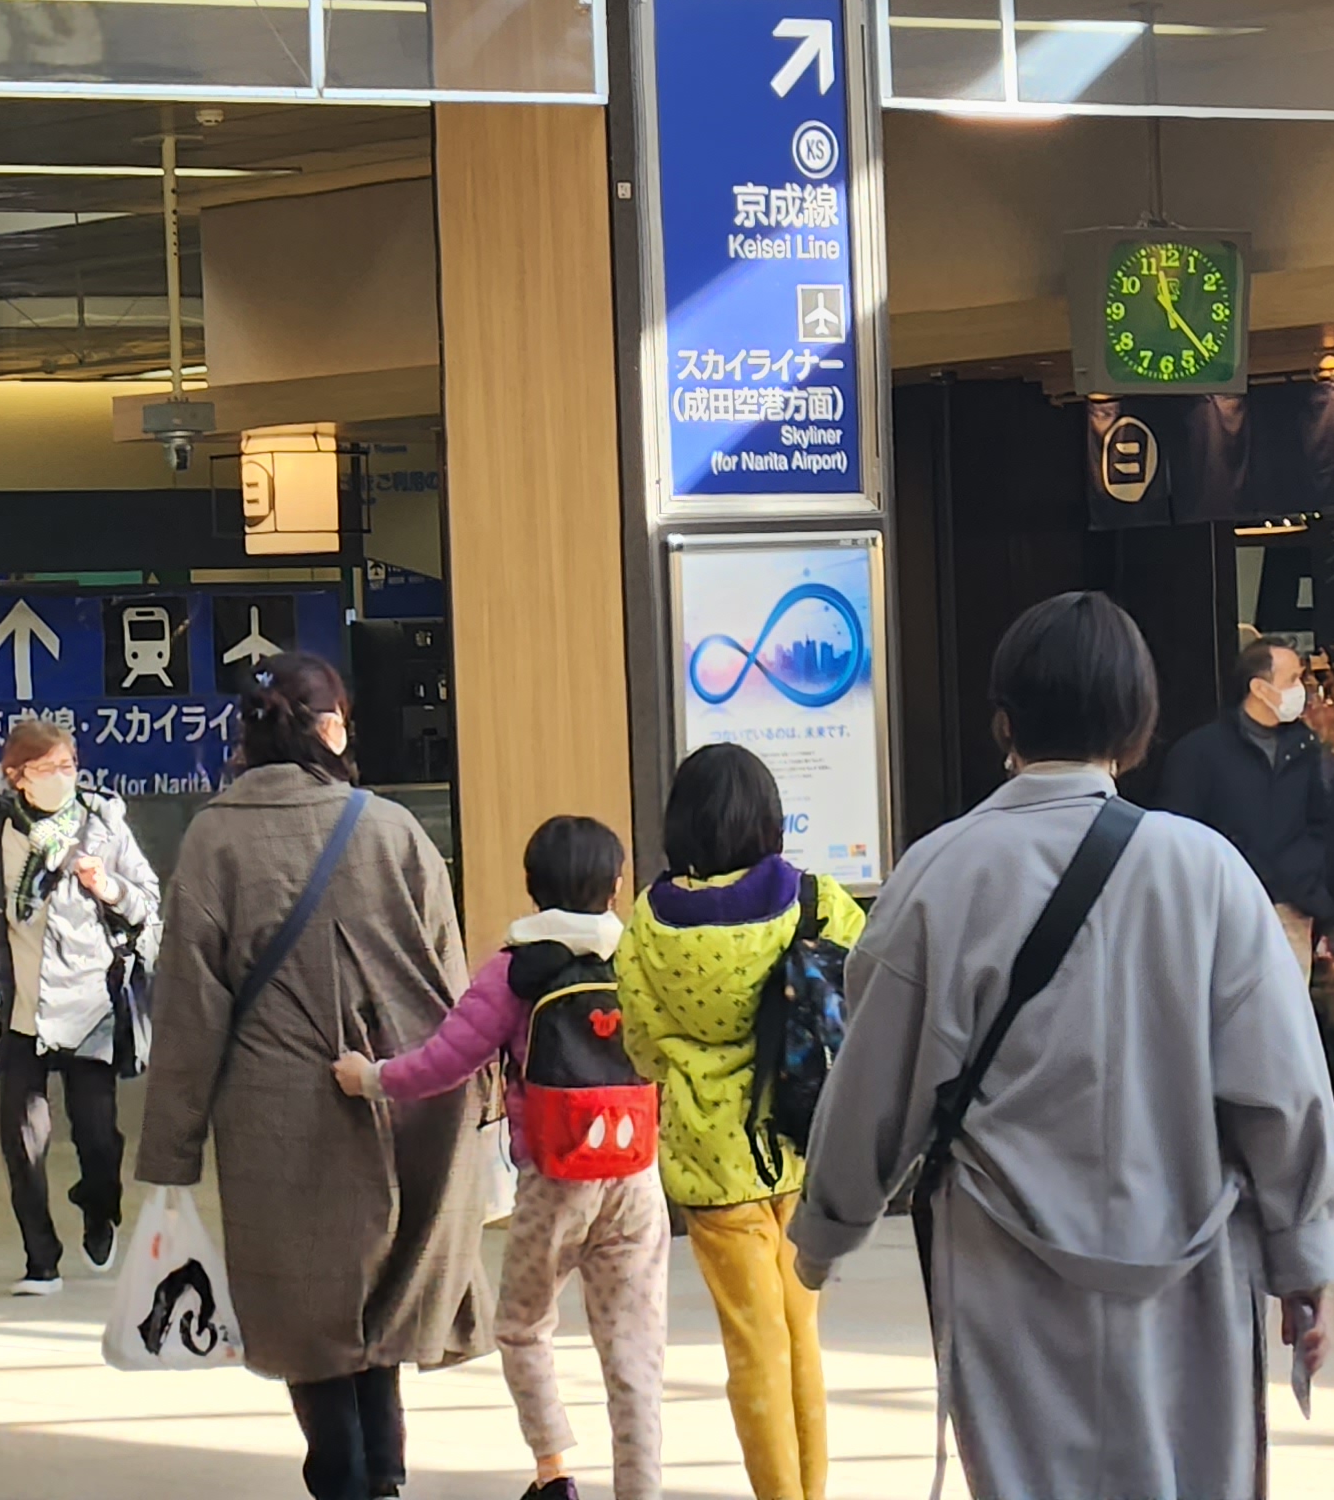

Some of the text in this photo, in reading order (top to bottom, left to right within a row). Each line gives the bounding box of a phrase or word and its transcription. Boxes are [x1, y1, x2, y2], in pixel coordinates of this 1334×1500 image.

[805, 138, 825, 160] KS
[733, 183, 839, 228] 京成線
[728, 234, 840, 260] Keisei Line
[1159, 249, 1180, 267] 12
[1186, 256, 1196, 273] 1
[1121, 276, 1141, 294] 10
[1203, 274, 1216, 291] 2
[1111, 302, 1126, 320] 9
[1212, 303, 1225, 320] 3
[1120, 332, 1134, 350] 8
[676, 348, 844, 381] スカイライナー
[1139, 350, 1153, 368] 7
[1160, 355, 1174, 373] 6
[1181, 350, 1195, 368] 5
[672, 386, 844, 422] (成田空港方面)
[780, 425, 843, 446] Skyliner
[711, 451, 848, 475] (for Narita Airport)
